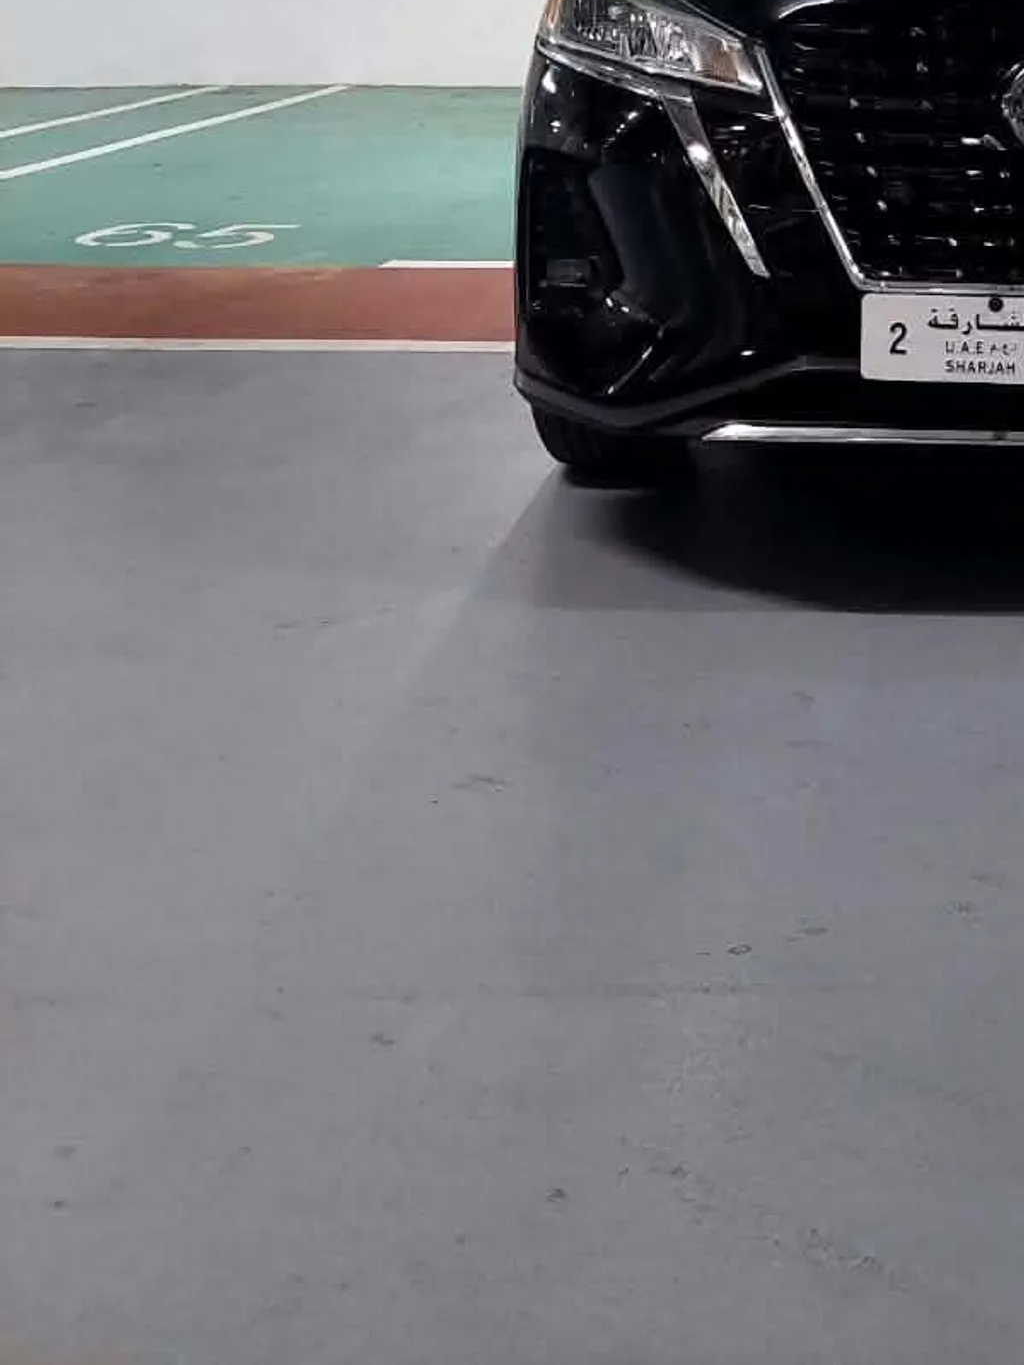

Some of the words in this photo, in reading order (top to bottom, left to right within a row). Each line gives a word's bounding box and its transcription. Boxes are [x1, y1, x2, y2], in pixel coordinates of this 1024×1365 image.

[75, 222, 301, 249] 65
[889, 322, 907, 355] 2
[944, 360, 1016, 375] SHARJAH
